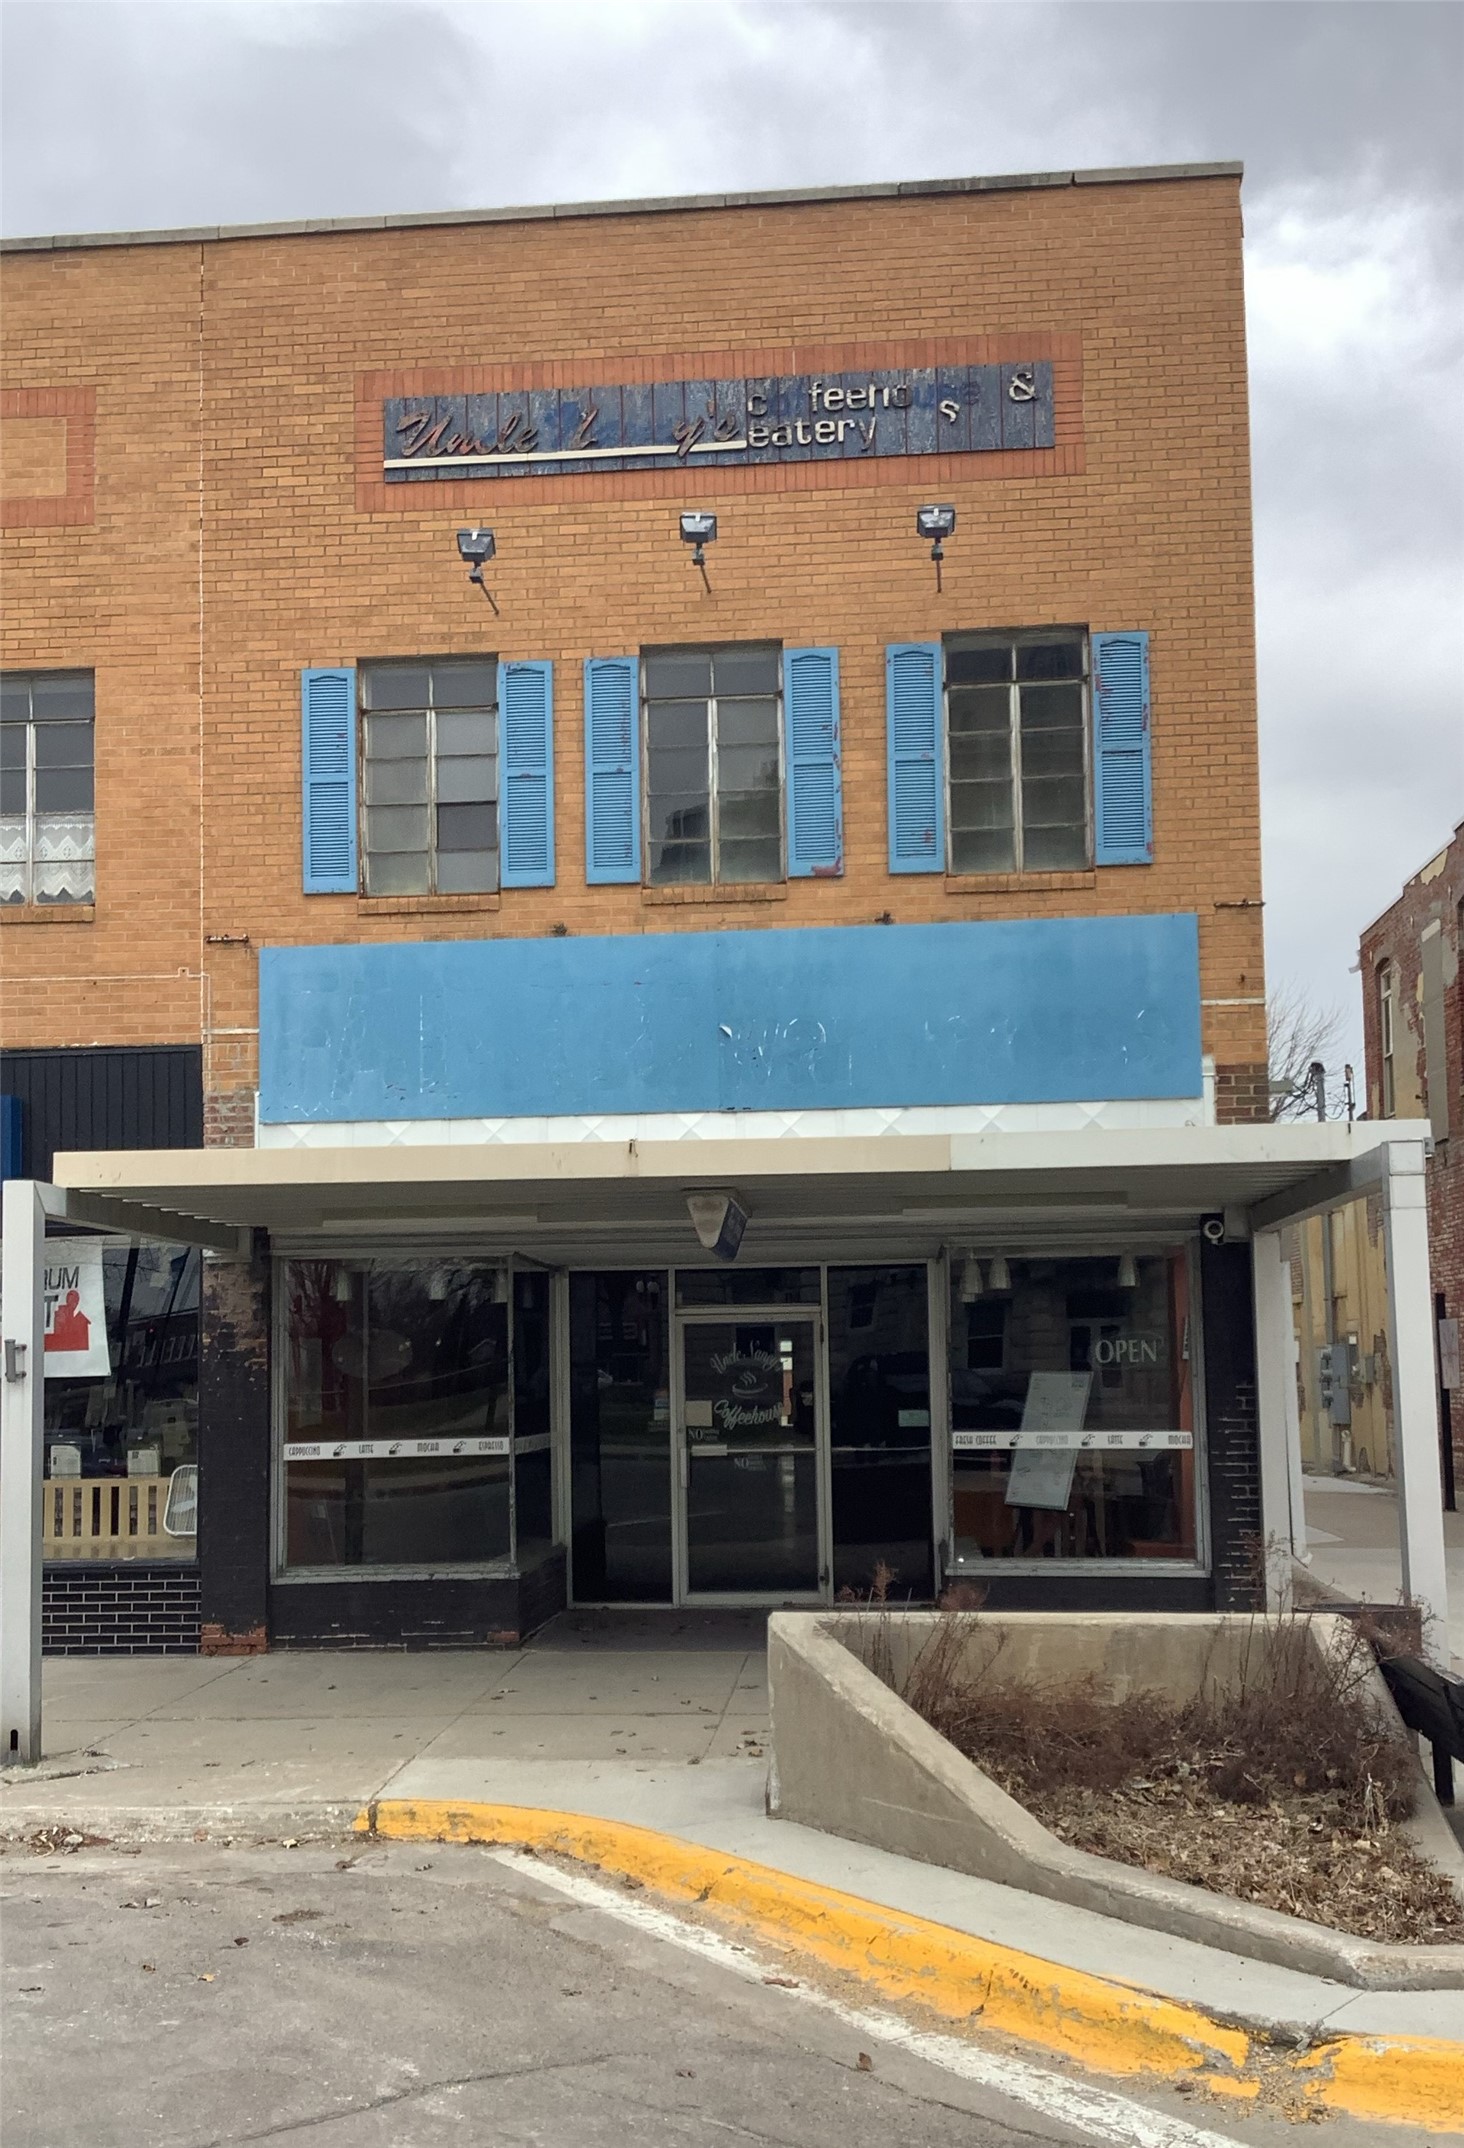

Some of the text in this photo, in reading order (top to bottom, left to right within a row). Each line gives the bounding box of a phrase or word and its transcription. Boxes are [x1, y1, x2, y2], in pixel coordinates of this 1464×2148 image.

[1008, 371, 1040, 403] &
[747, 417, 877, 451] eatery
[1095, 1338, 1157, 1364] OPEN
[714, 1399, 783, 1430] Coffeehouse
